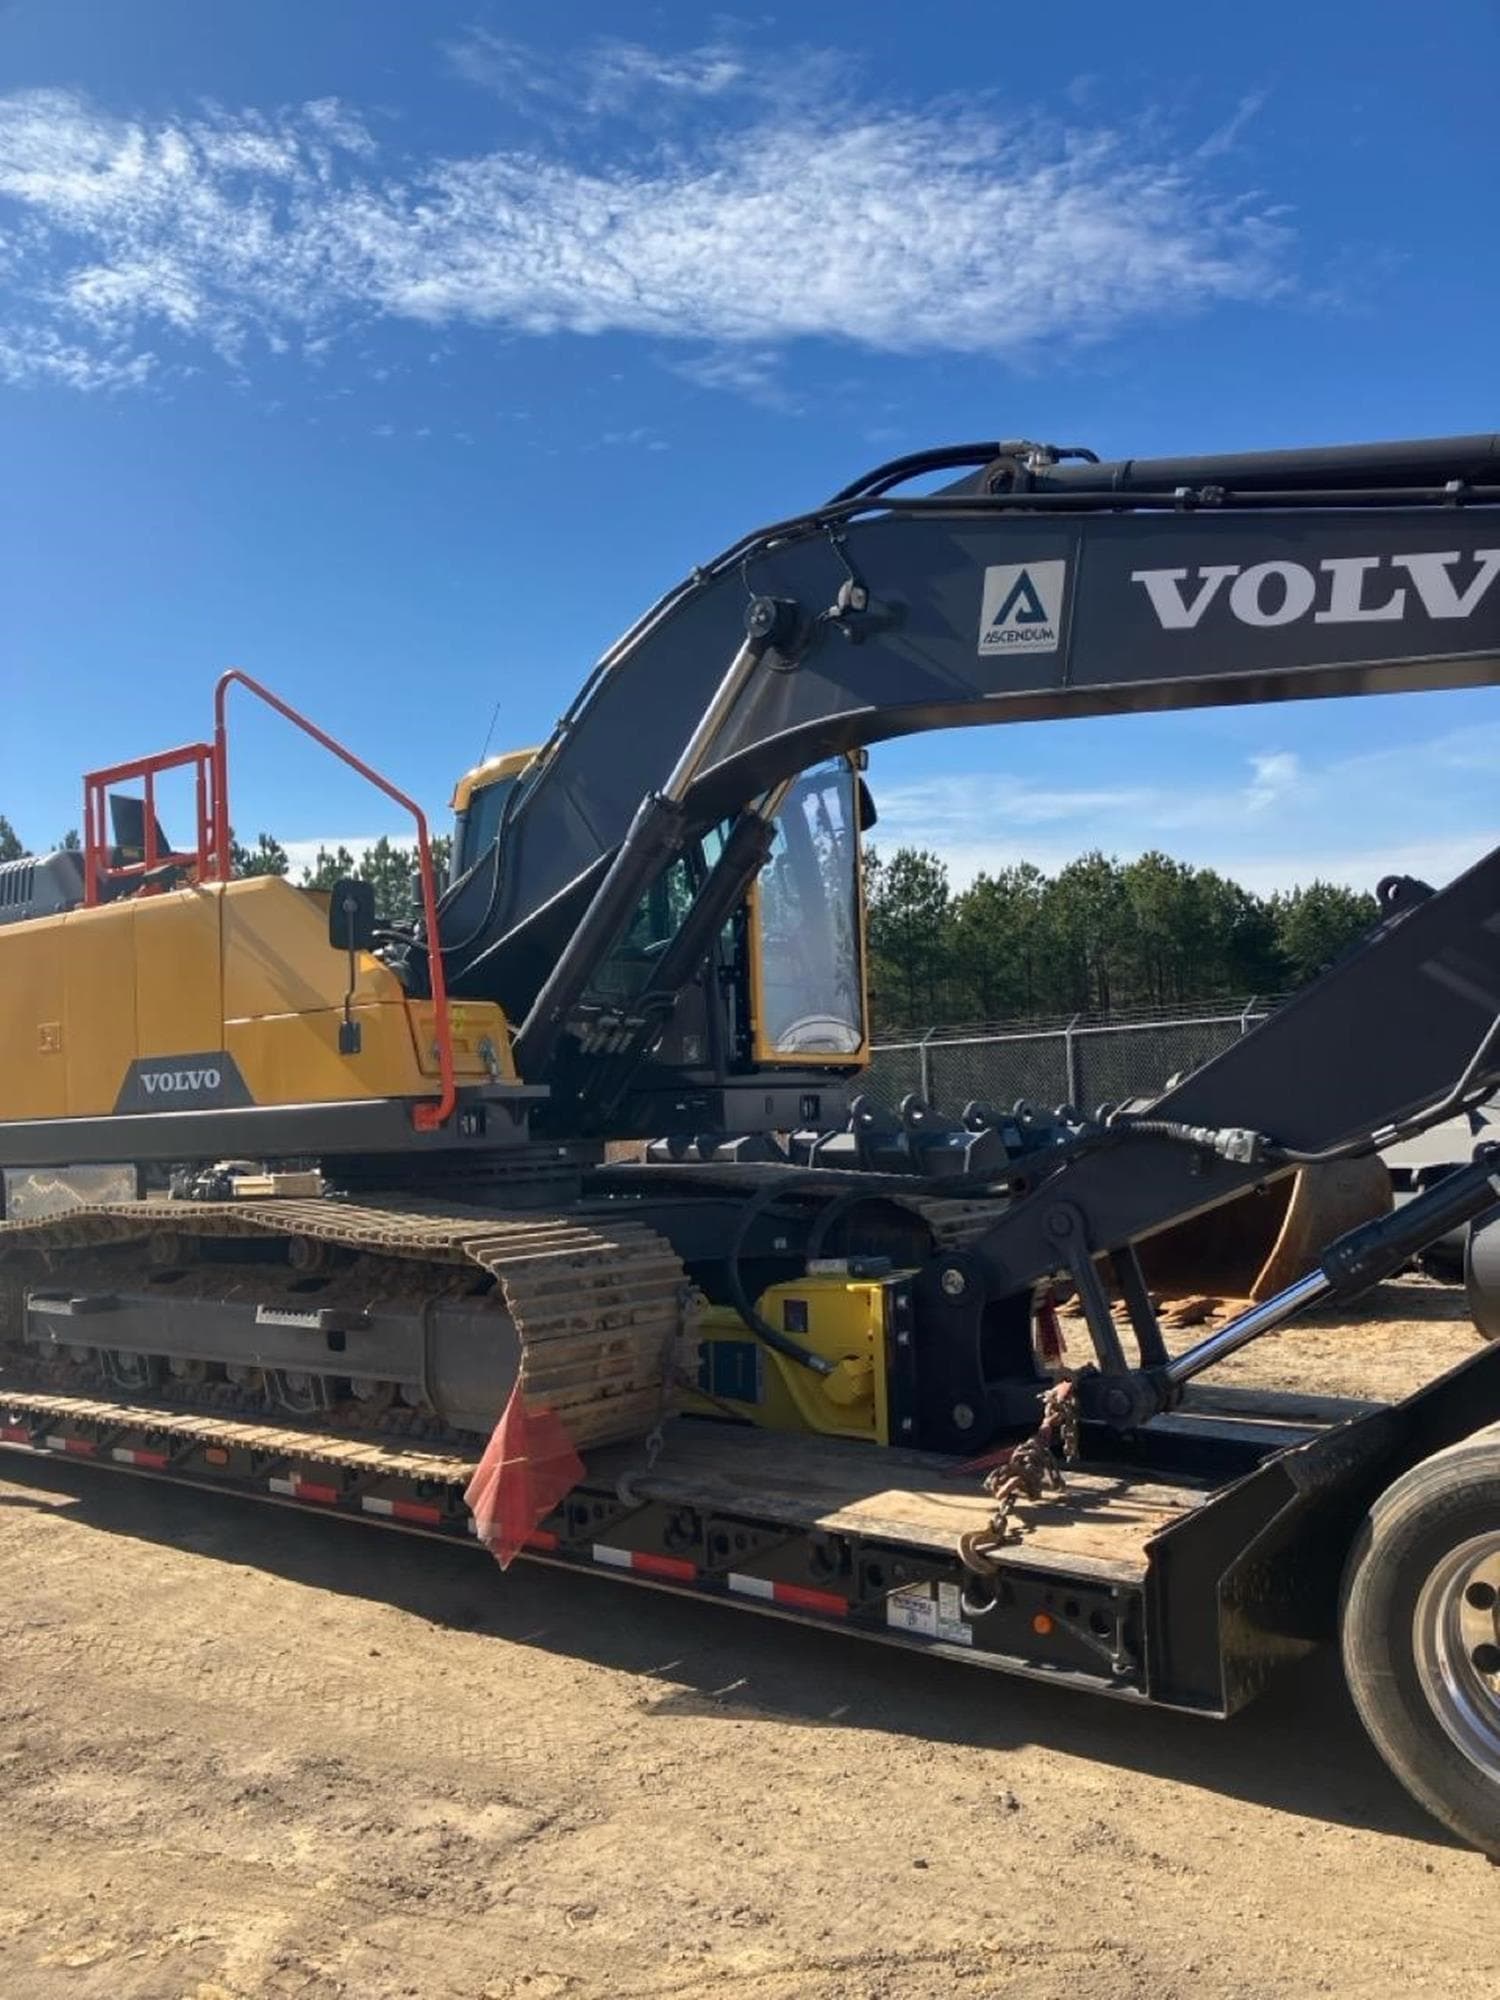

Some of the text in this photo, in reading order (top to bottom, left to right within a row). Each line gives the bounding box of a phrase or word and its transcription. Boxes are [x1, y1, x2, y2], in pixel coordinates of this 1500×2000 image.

[1131, 549, 1500, 629] VOLV
[983, 627, 1055, 644] ASCENDUM
[140, 1068, 221, 1094] VOLVO
